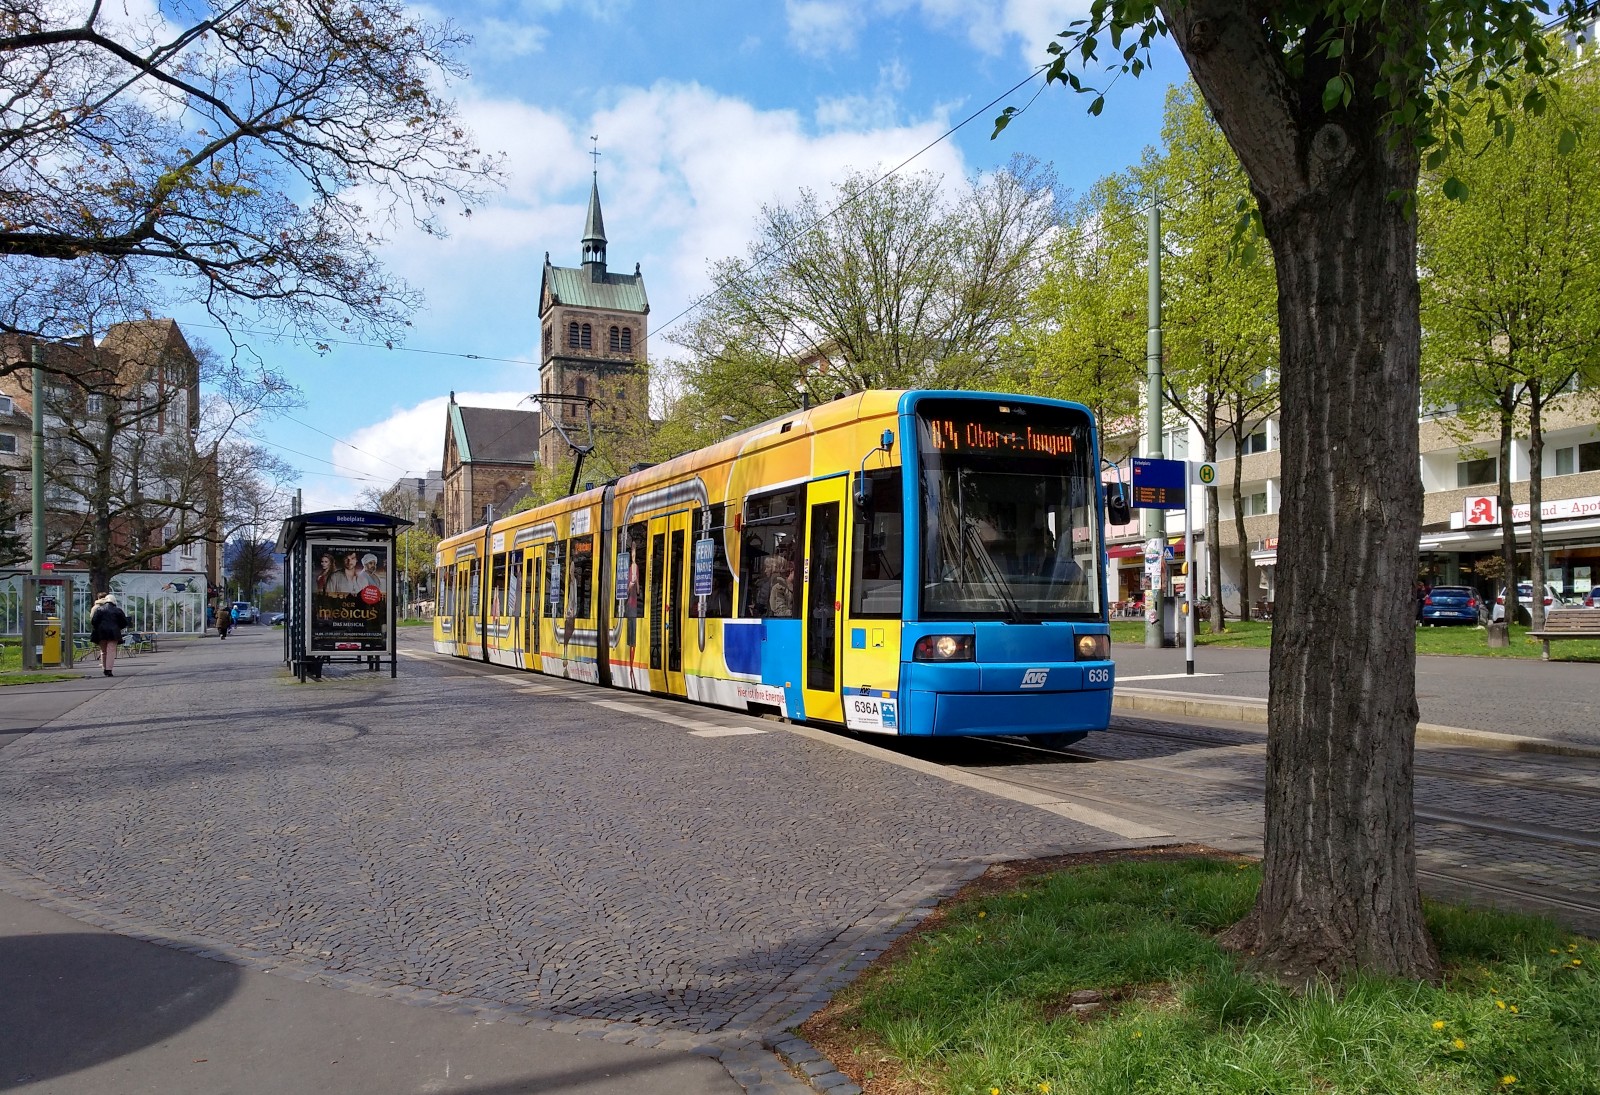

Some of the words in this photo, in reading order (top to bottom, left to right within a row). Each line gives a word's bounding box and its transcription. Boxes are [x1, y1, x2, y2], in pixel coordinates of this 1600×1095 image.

[1203, 468, 1211, 479] H
[336, 515, 365, 523] Bebelplatz
[1021, 670, 1048, 685] KVG
[1089, 669, 1109, 683] 636
[854, 700, 879, 715] 636A
